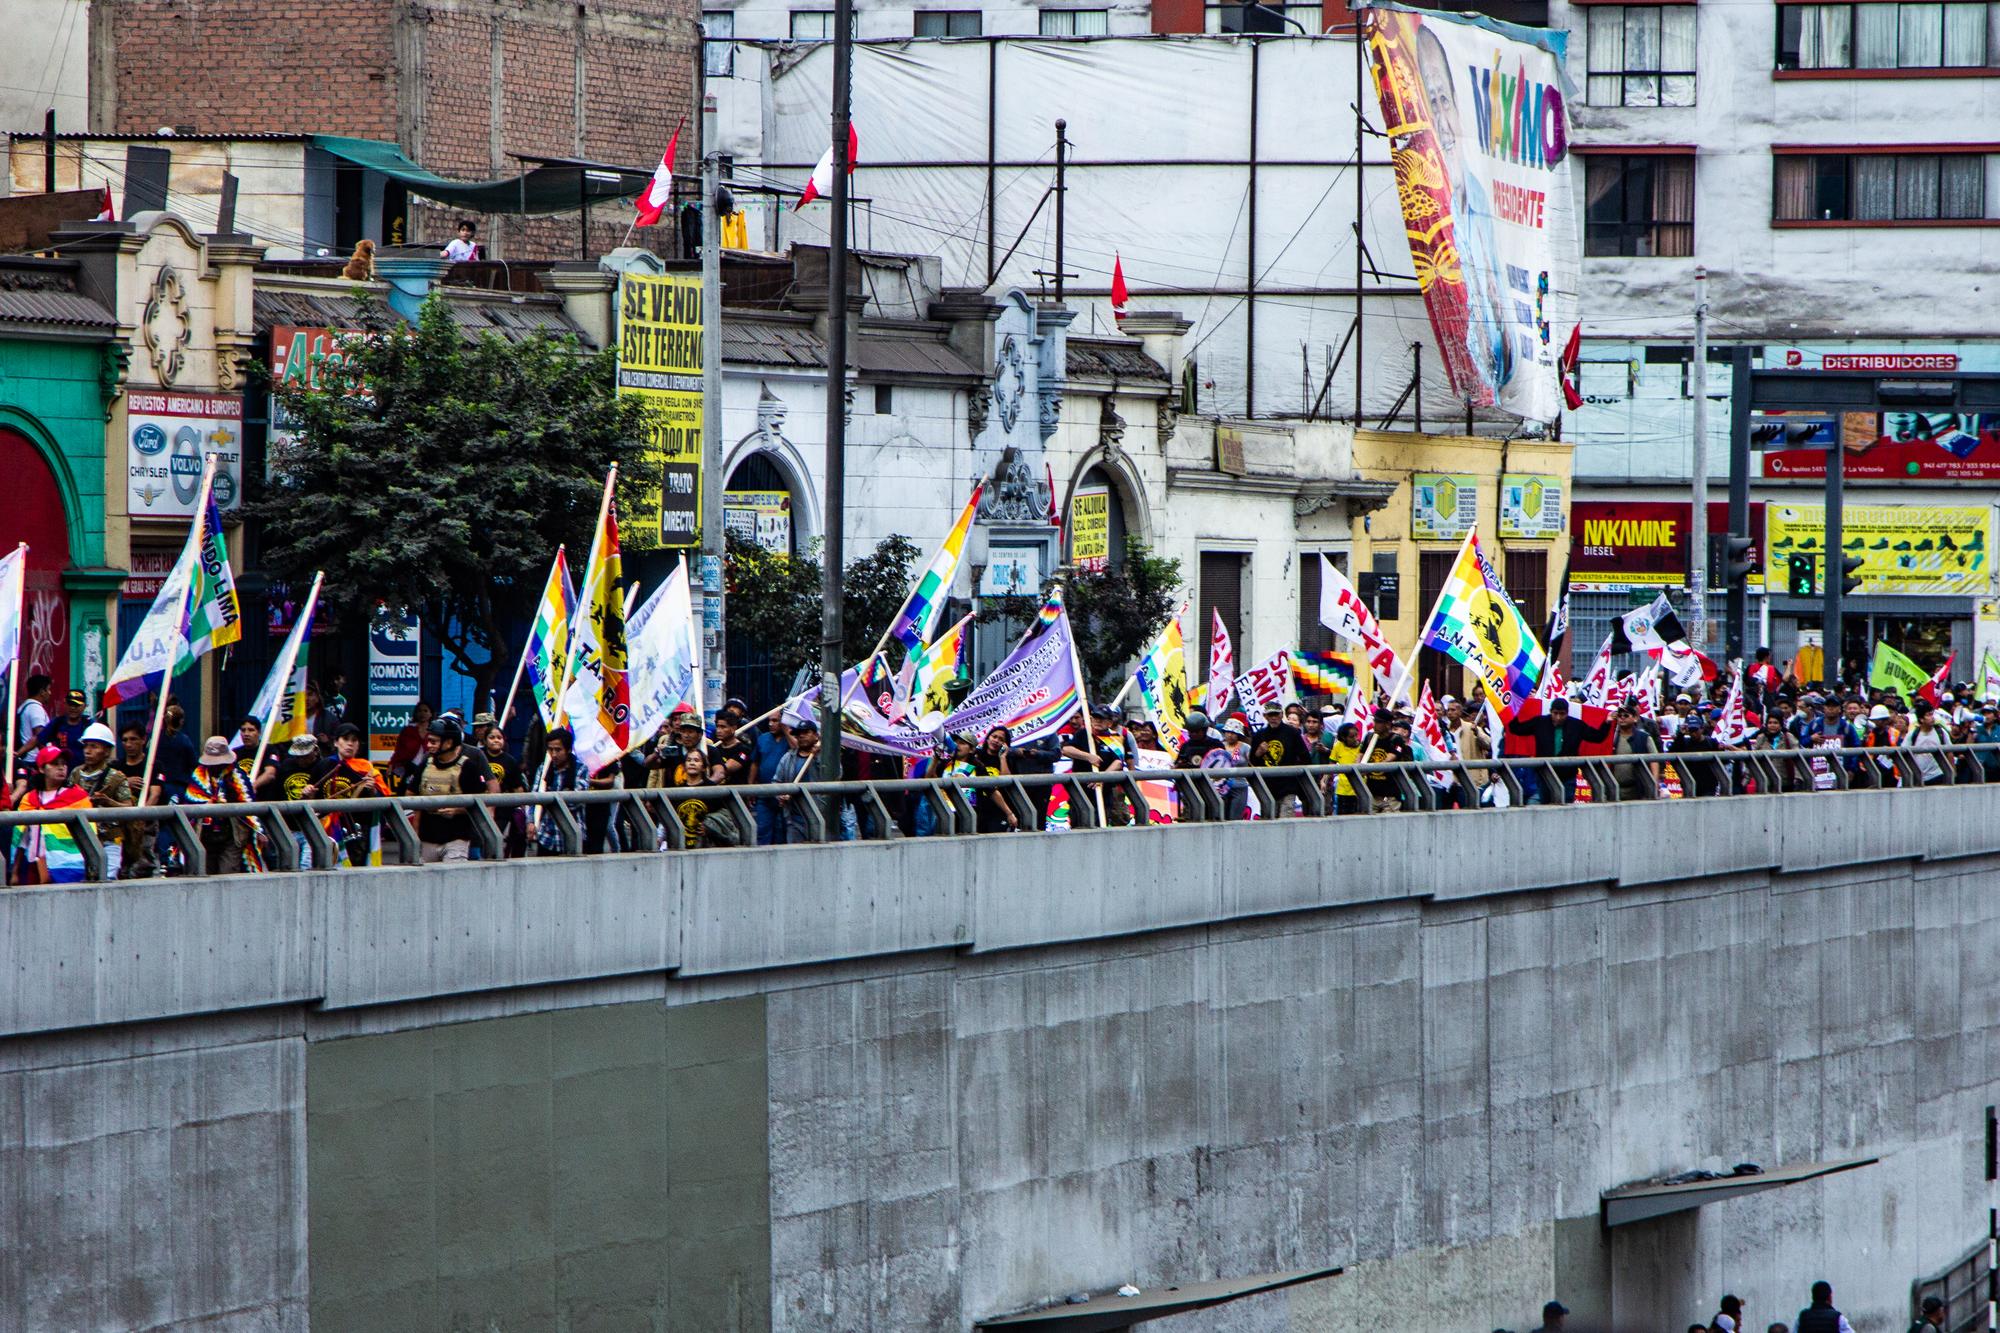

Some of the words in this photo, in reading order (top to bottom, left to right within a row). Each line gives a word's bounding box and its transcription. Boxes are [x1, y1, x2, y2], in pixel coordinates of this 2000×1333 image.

[1493, 179, 1545, 229] PRESIDENTE
[624, 280, 646, 320] SE
[623, 324, 651, 365] ESTE
[129, 395, 166, 411] REPUESTOS
[167, 397, 203, 414] AMERICANO
[205, 399, 211, 414] &
[211, 399, 240, 415] EUROPEO
[138, 428, 160, 449] Ford
[130, 466, 169, 478] CHRYSLER
[172, 457, 200, 473] VOLVO
[669, 472, 693, 494] TRATO
[1075, 498, 1082, 516] SE
[663, 510, 694, 532] DIRECTO
[1583, 519, 1677, 547] NAKAMINE
[1583, 547, 1615, 556] DIESEL
[131, 554, 161, 572] TOPARTES
[213, 578, 239, 628] LIMA
[370, 663, 419, 679] KOMATSU
[1022, 657, 1034, 669] DE
[371, 683, 399, 692] Genuine
[400, 683, 418, 692] Parts
[960, 676, 1023, 711] ANTIPOPULAR
[371, 711, 412, 728] Kubot
